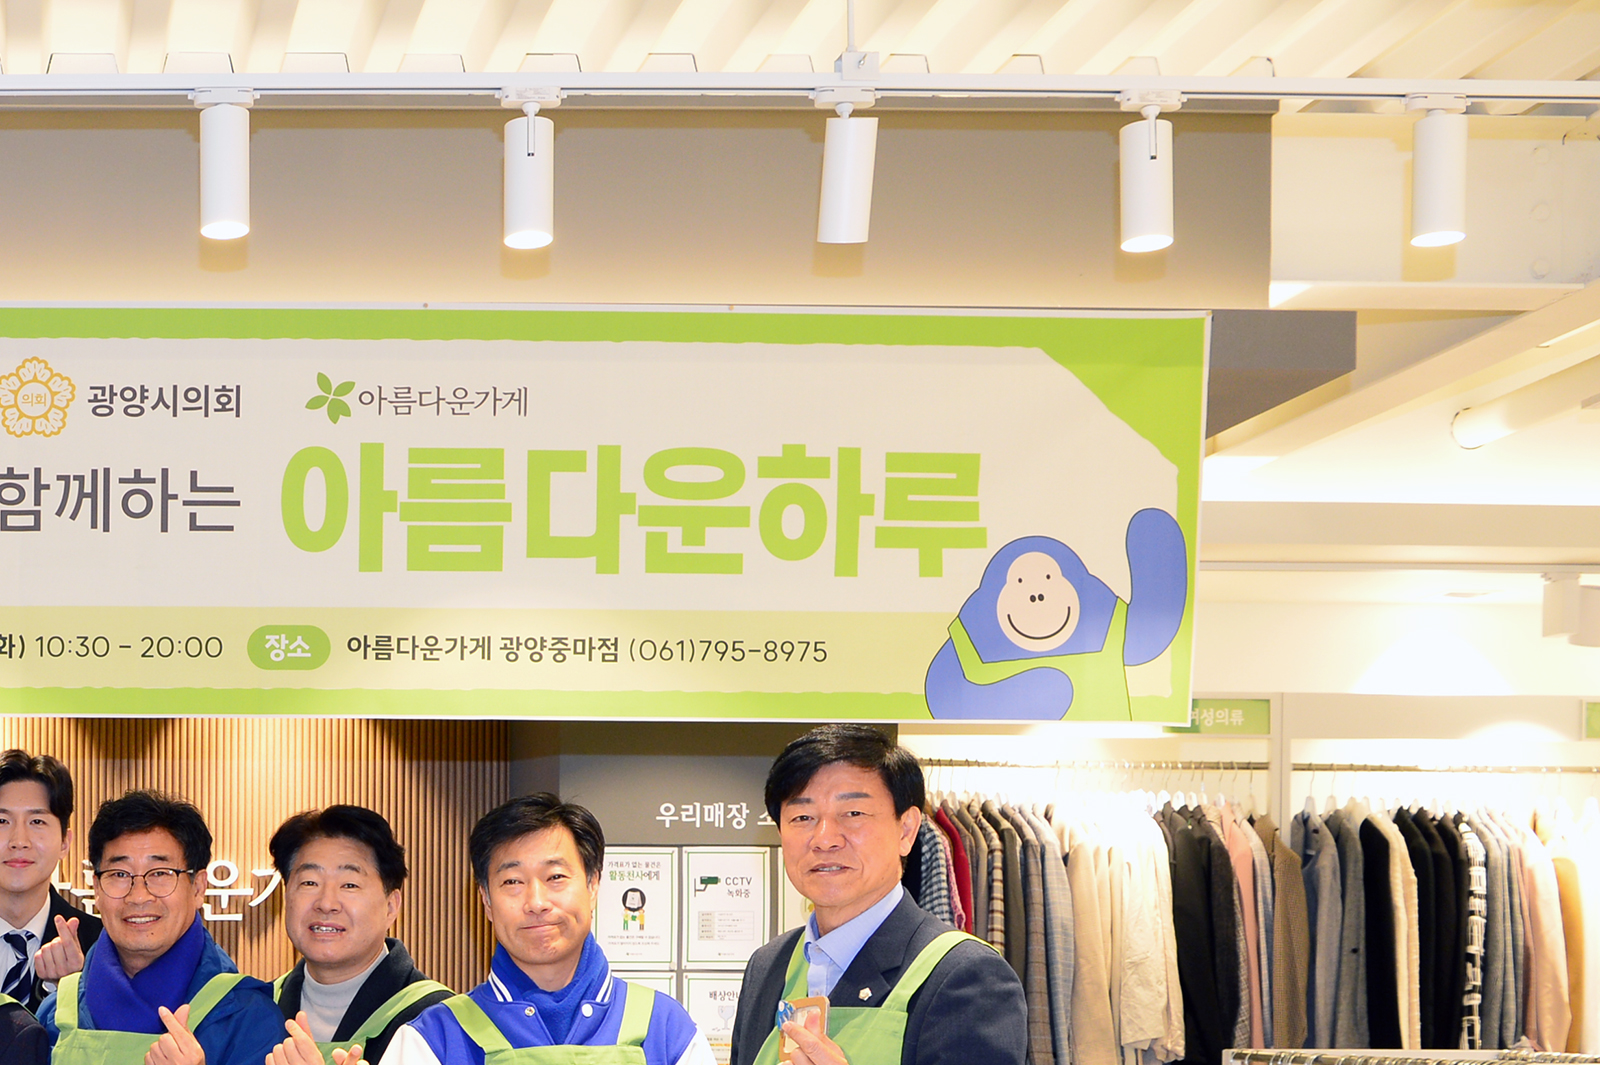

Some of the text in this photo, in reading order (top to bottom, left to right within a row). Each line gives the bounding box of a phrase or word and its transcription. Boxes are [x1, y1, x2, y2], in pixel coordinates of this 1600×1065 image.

[21, 392, 48, 407] 의회
[87, 384, 242, 418] 광양시의회
[358, 386, 529, 418] 아름다운가게
[279, 442, 989, 579] 아름다운하루
[35, 635, 111, 659] 10:30
[140, 636, 224, 659] 20:00
[265, 634, 312, 662] 장소
[346, 634, 829, 664] 아름다운가게 광양중마점 (061)795-8975
[1191, 708, 1245, 727] 여성의류
[655, 802, 777, 830] 우리매장 소
[607, 861, 631, 869] 가격표가
[631, 861, 643, 869] 없는
[608, 870, 660, 881] 활동천사에게
[725, 877, 752, 886] CCTV
[727, 889, 751, 898] 녹화중
